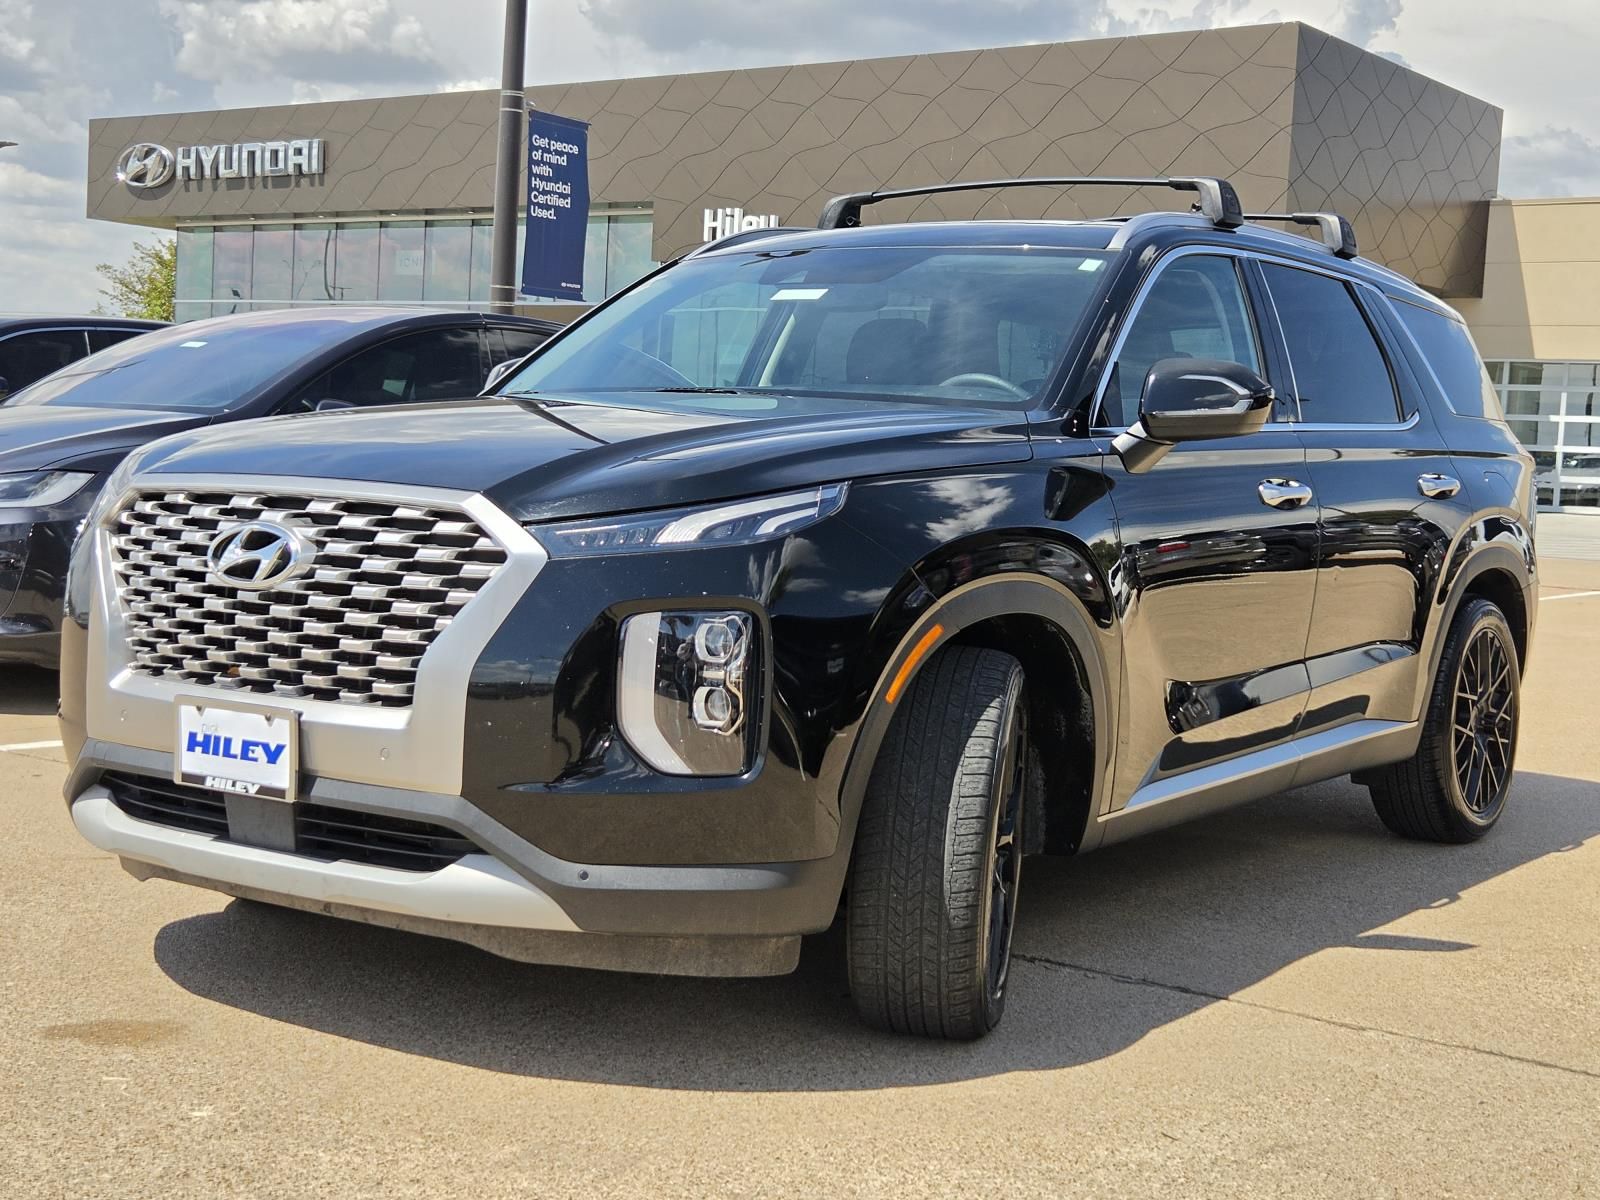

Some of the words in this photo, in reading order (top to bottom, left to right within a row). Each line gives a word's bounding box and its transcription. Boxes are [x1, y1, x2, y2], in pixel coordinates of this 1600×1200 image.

[532, 134, 549, 149] Get
[550, 139, 579, 154] peace
[176, 139, 324, 180] HYUNDAI
[532, 149, 542, 160] of
[543, 152, 567, 166] mind
[532, 164, 552, 177] with
[531, 177, 571, 194] Hyundai
[531, 191, 571, 208] Certified
[530, 205, 557, 220] Used.
[186, 731, 287, 765] HILEY
[204, 775, 261, 795] HILEY
